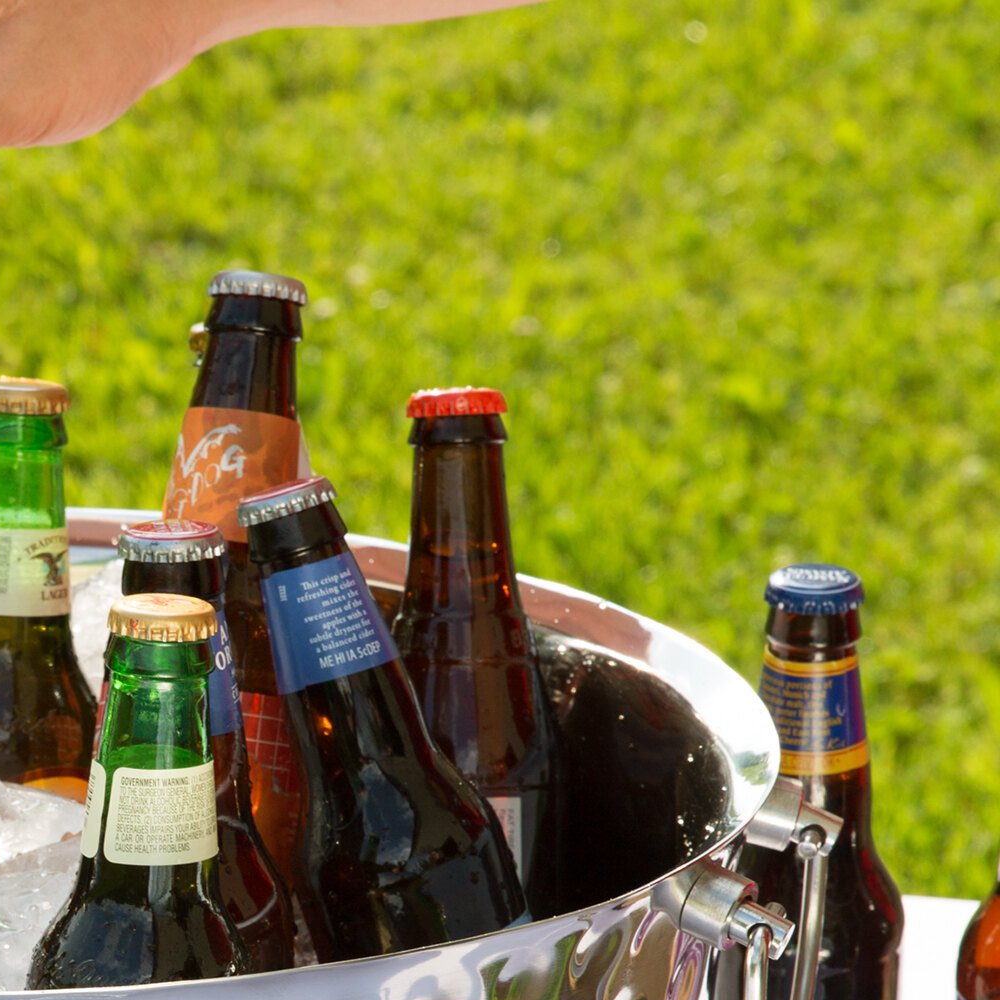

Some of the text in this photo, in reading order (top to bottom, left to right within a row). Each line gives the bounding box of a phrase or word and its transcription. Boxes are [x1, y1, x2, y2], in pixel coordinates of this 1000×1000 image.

[296, 585, 340, 604] refreshing
[340, 580, 355, 590] cider
[301, 580, 318, 591] This
[320, 574, 340, 588] crisp
[322, 589, 360, 607] mixes the
[304, 599, 363, 624] sweetness of the
[322, 617, 347, 631] apples
[347, 611, 362, 622] with
[309, 618, 371, 645] subtle dryness for
[321, 635, 358, 653] balanced
[359, 629, 374, 639] cider
[319, 656, 334, 669] ME
[335, 651, 346, 666] HI
[345, 648, 358, 663] IA
[121, 776, 160, 786] GOVERNMENT
[114, 843, 133, 853] CAUSE
[134, 843, 158, 854] HEALTH
[121, 833, 133, 842] CAR
[135, 834, 144, 843] OR
[145, 834, 174, 844] OPERATE
